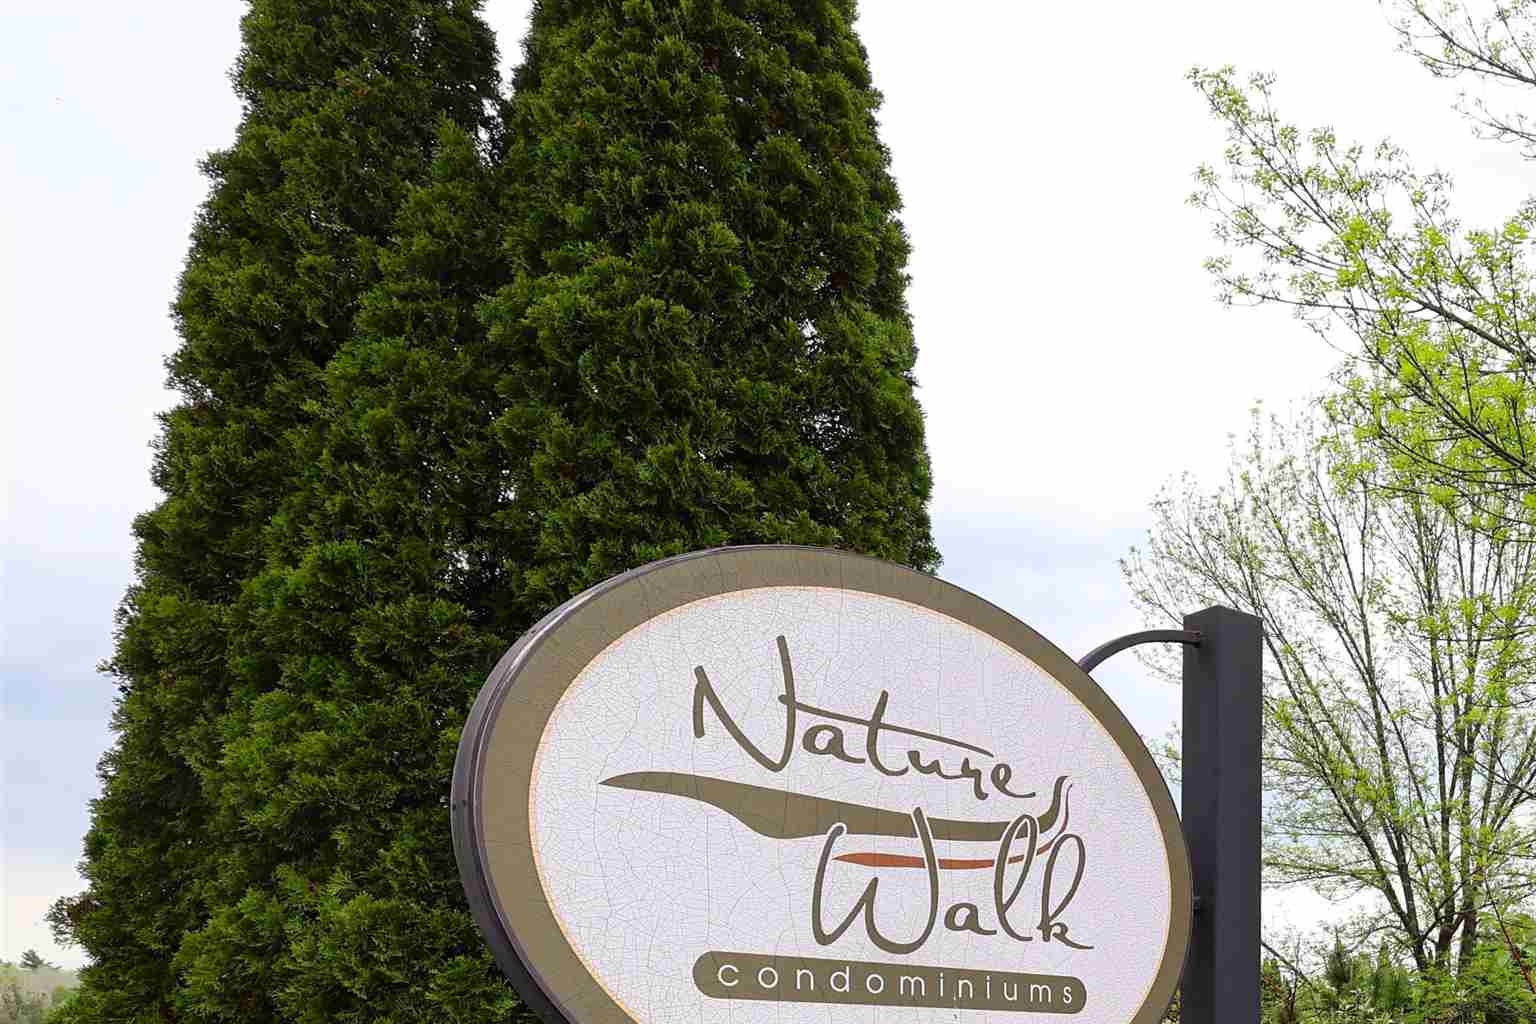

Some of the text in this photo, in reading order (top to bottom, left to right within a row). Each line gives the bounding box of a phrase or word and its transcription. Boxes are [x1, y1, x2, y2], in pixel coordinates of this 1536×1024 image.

[692, 634, 1037, 800] Nature
[811, 806, 1094, 954] Walk
[716, 961, 1074, 1005] condominiums
